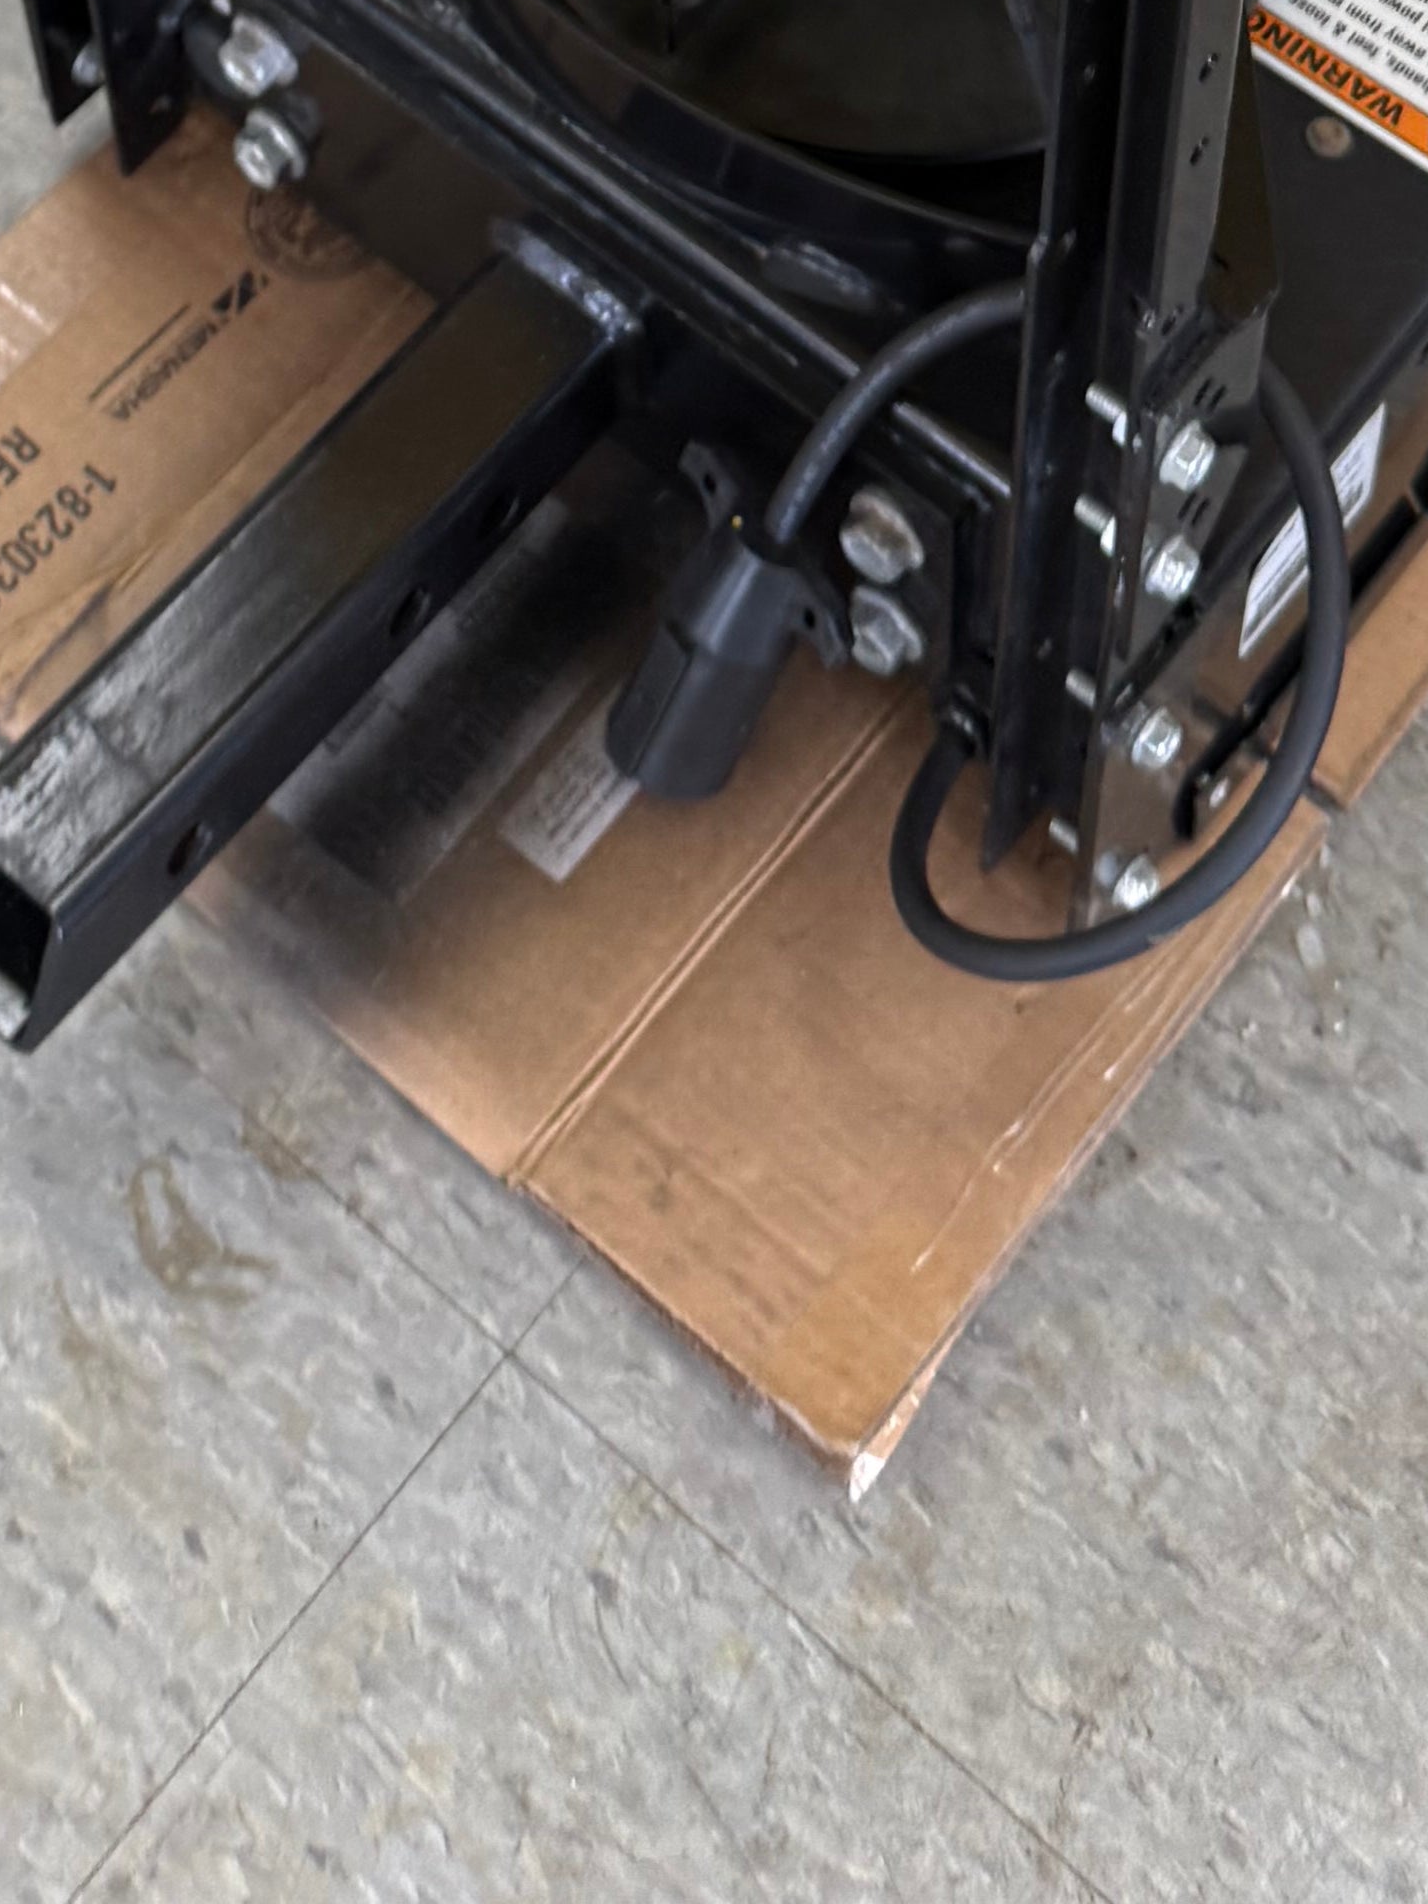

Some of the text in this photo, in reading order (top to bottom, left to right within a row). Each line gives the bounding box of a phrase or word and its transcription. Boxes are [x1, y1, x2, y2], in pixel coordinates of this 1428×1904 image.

[1332, 21, 1347, 37] &
[1345, 3, 1383, 34] from
[1346, 31, 1380, 59] feet
[1383, 27, 1427, 60] away
[1246, 9, 1405, 126] WARNING
